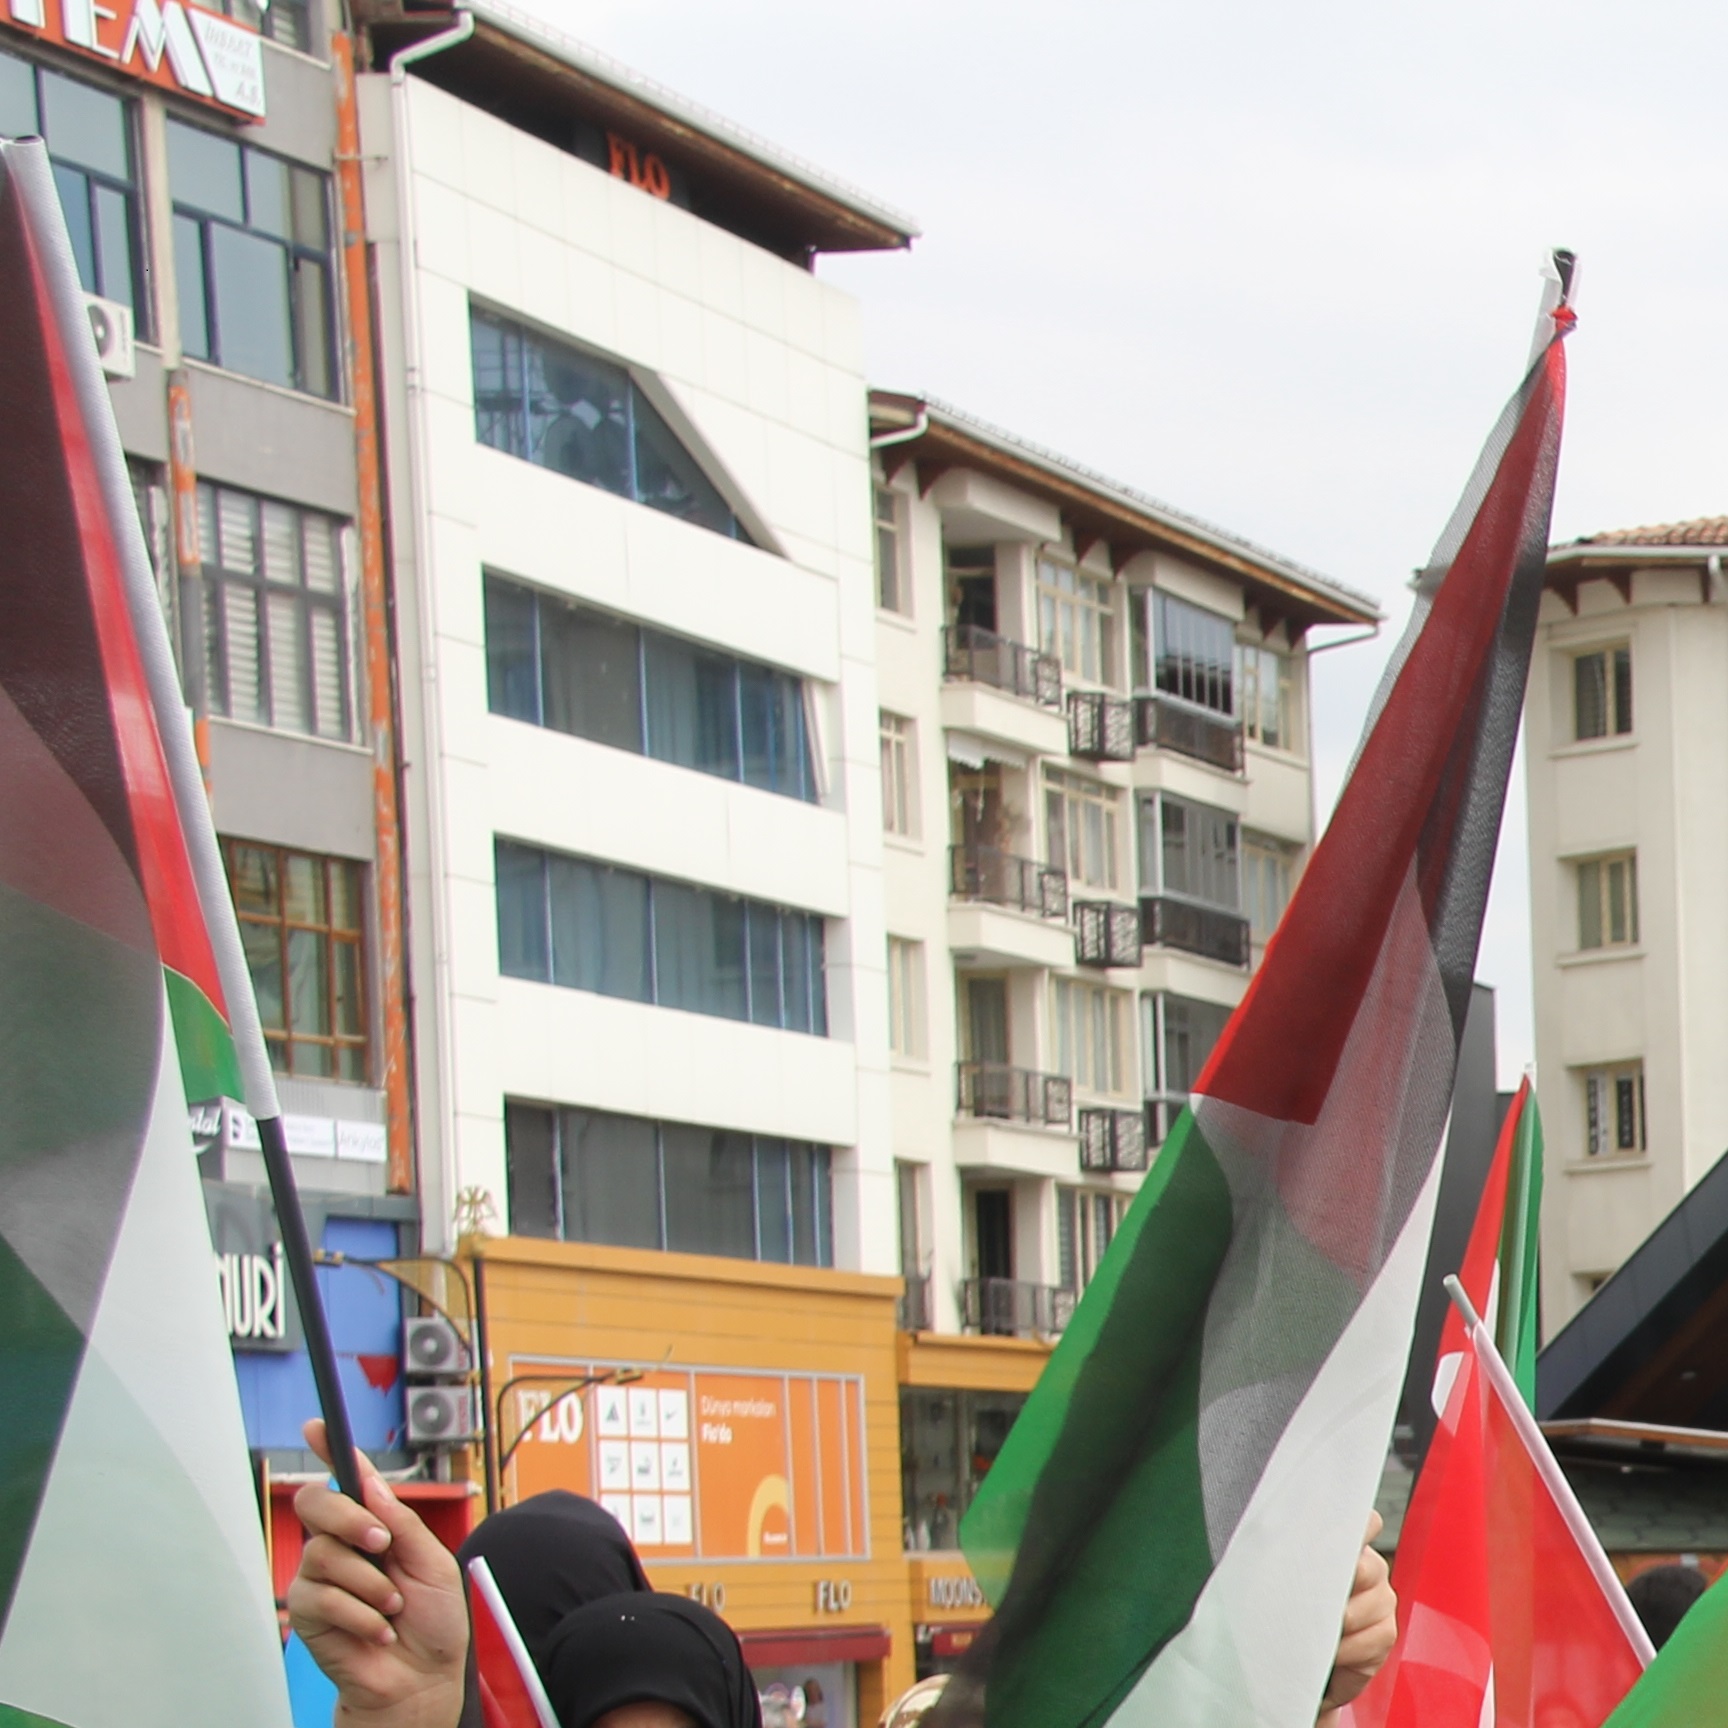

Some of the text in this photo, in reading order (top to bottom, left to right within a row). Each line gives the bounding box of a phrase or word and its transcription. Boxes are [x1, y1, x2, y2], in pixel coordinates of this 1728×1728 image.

[516, 1388, 583, 1443] FLO
[816, 1579, 851, 1612] FLO
[929, 1576, 984, 1608] MOONS
